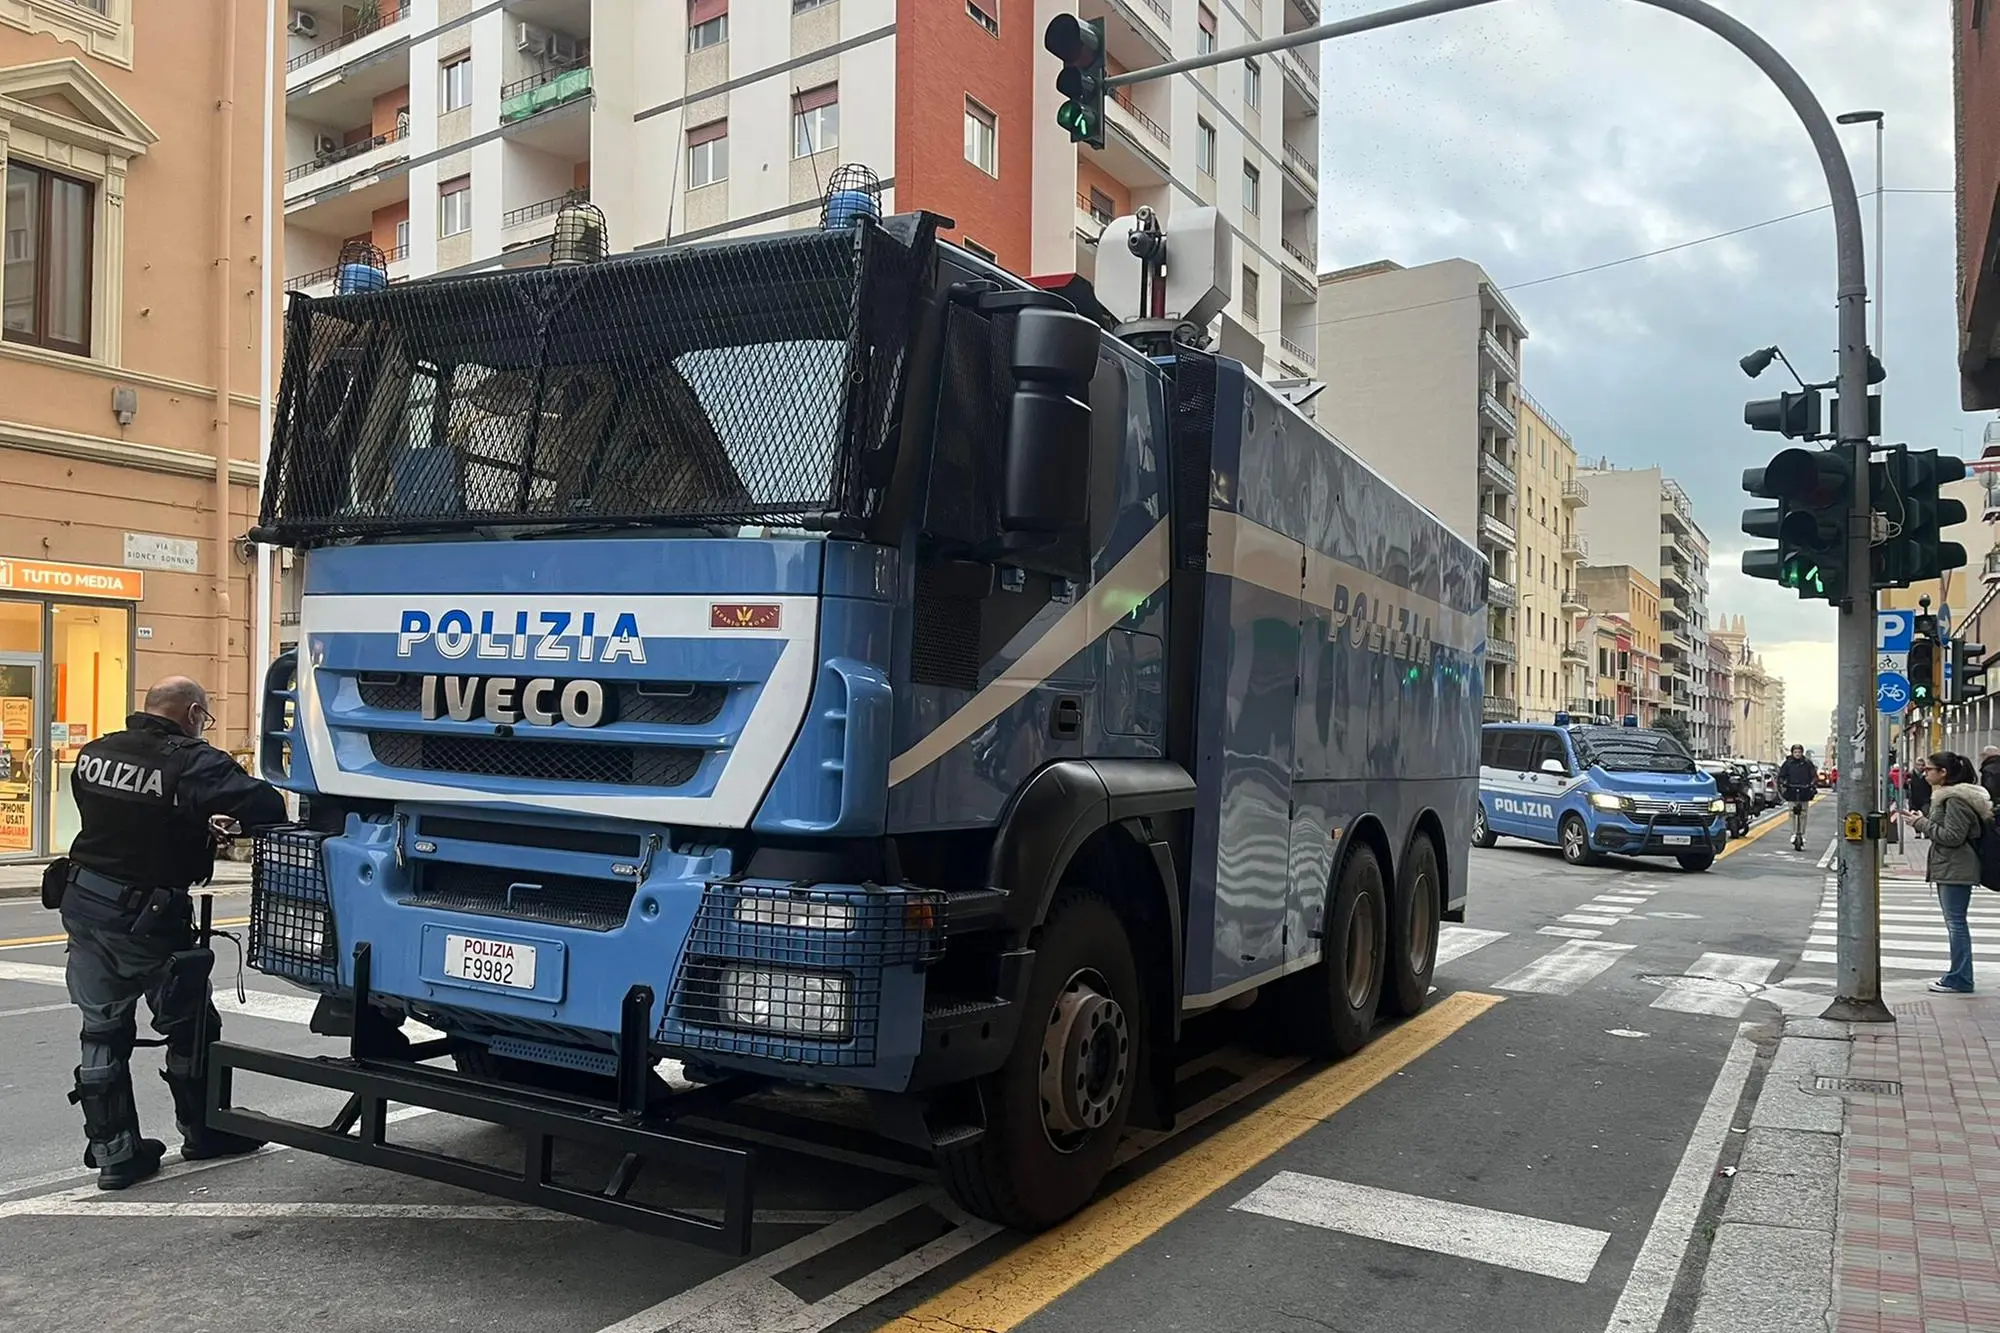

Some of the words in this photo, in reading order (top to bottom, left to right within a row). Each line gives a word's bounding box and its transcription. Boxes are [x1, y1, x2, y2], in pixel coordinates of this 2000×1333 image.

[22, 568, 72, 586] TUTTO
[75, 573, 123, 590] MEDIA
[397, 609, 648, 664] POLIZIA
[1328, 584, 1431, 666] POLIZIA
[1878, 615, 1905, 649] P
[421, 675, 606, 729] IVECO
[78, 754, 163, 797] POLIZIA
[6, 814, 25, 825] USATI
[1495, 798, 1553, 819] POLIZIA
[464, 939, 514, 960] POLIZIA
[463, 957, 513, 985] F9982
